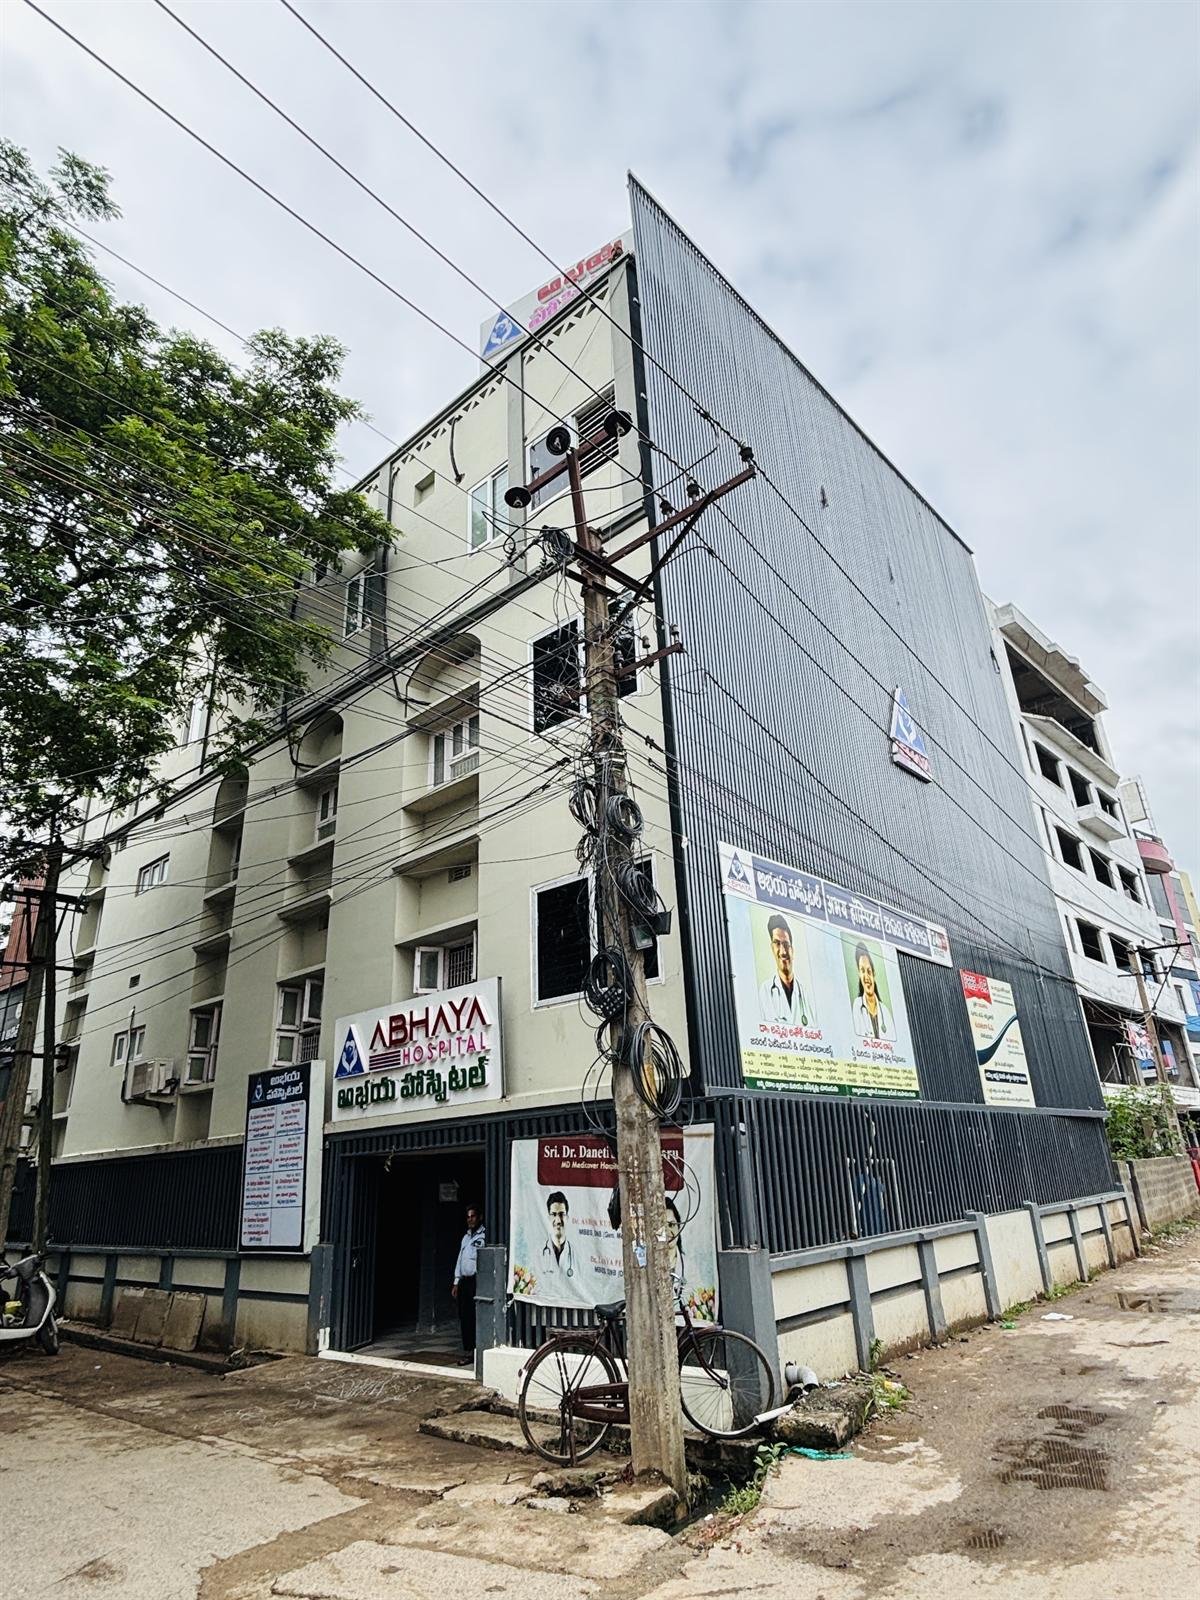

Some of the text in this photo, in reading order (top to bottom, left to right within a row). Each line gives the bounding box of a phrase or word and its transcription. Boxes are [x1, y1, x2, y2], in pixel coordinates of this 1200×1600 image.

[826, 894, 848, 919] अभय
[369, 995, 487, 1050] ABHAYA
[402, 1032, 486, 1065] HOSPITAL
[270, 1070, 300, 1085] అభయ
[337, 1076, 396, 1108] అభయ
[543, 1145, 560, 1158] Sri.
[562, 1145, 577, 1158] Dr.
[579, 1145, 610, 1159] Daneti
[571, 1161, 599, 1169] Medicover
